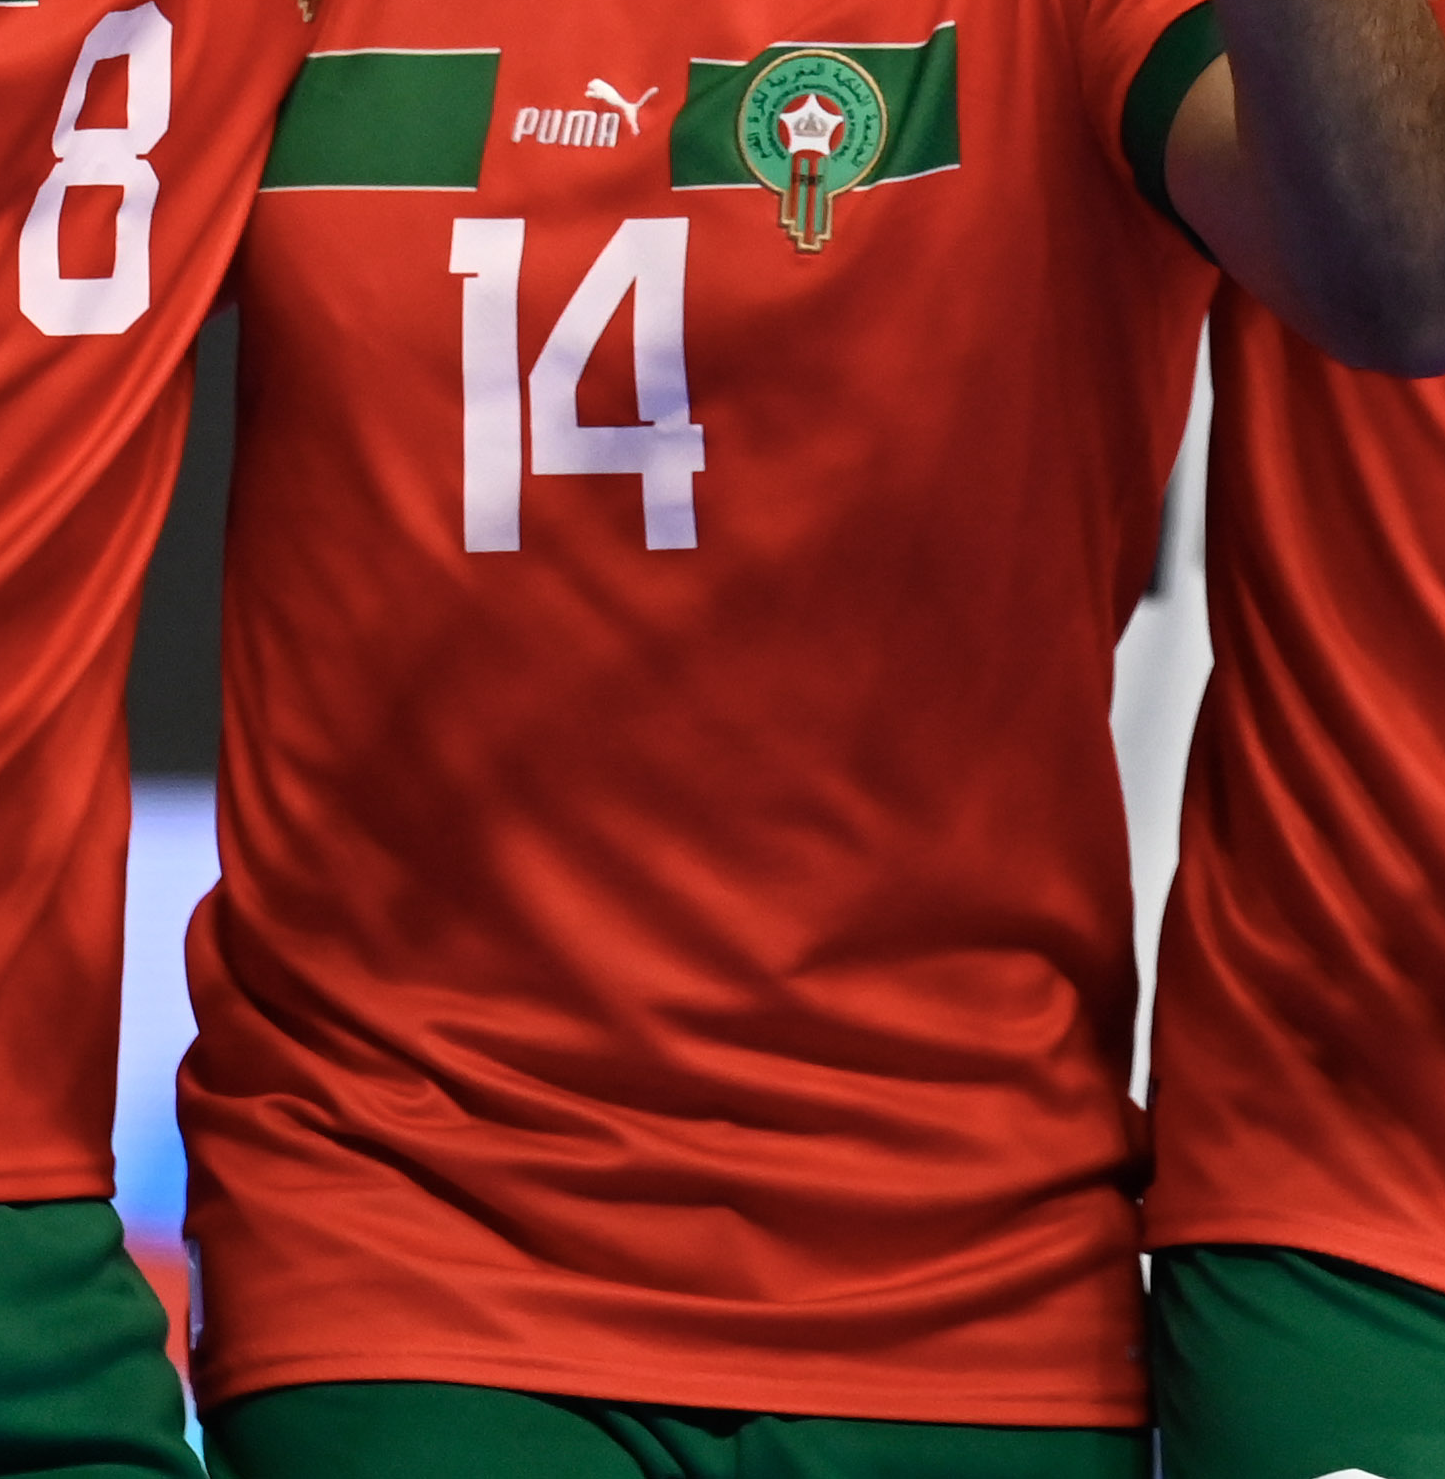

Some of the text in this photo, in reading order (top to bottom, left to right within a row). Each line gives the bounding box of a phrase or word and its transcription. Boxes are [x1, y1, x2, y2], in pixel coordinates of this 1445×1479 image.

[18, 1, 174, 336] 8
[511, 106, 621, 148] PUMA
[448, 217, 706, 553] 14
